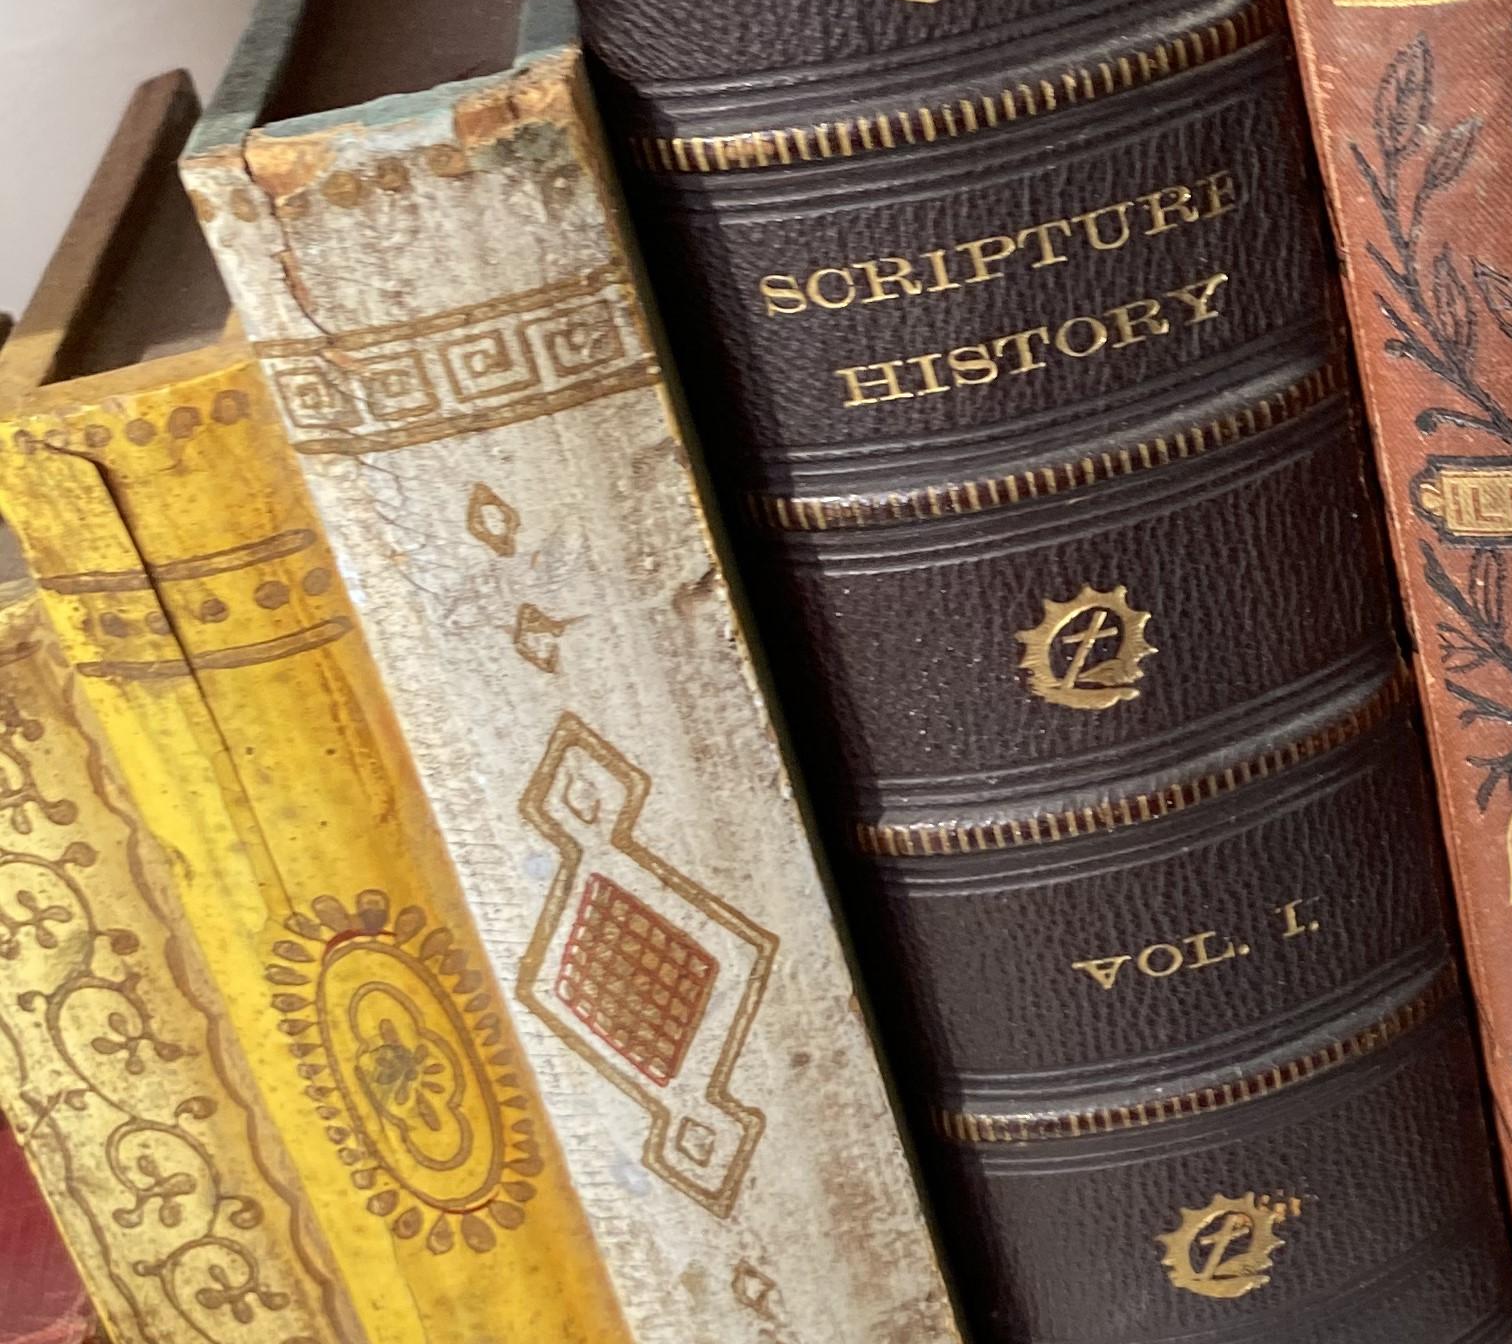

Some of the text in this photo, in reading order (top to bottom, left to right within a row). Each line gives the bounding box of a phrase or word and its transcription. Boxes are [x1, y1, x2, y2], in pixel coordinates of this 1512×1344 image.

[758, 169, 1238, 318] SCRIPTURE
[834, 272, 1229, 409] HISTORY
[1072, 894, 1321, 990] VOL. I.
